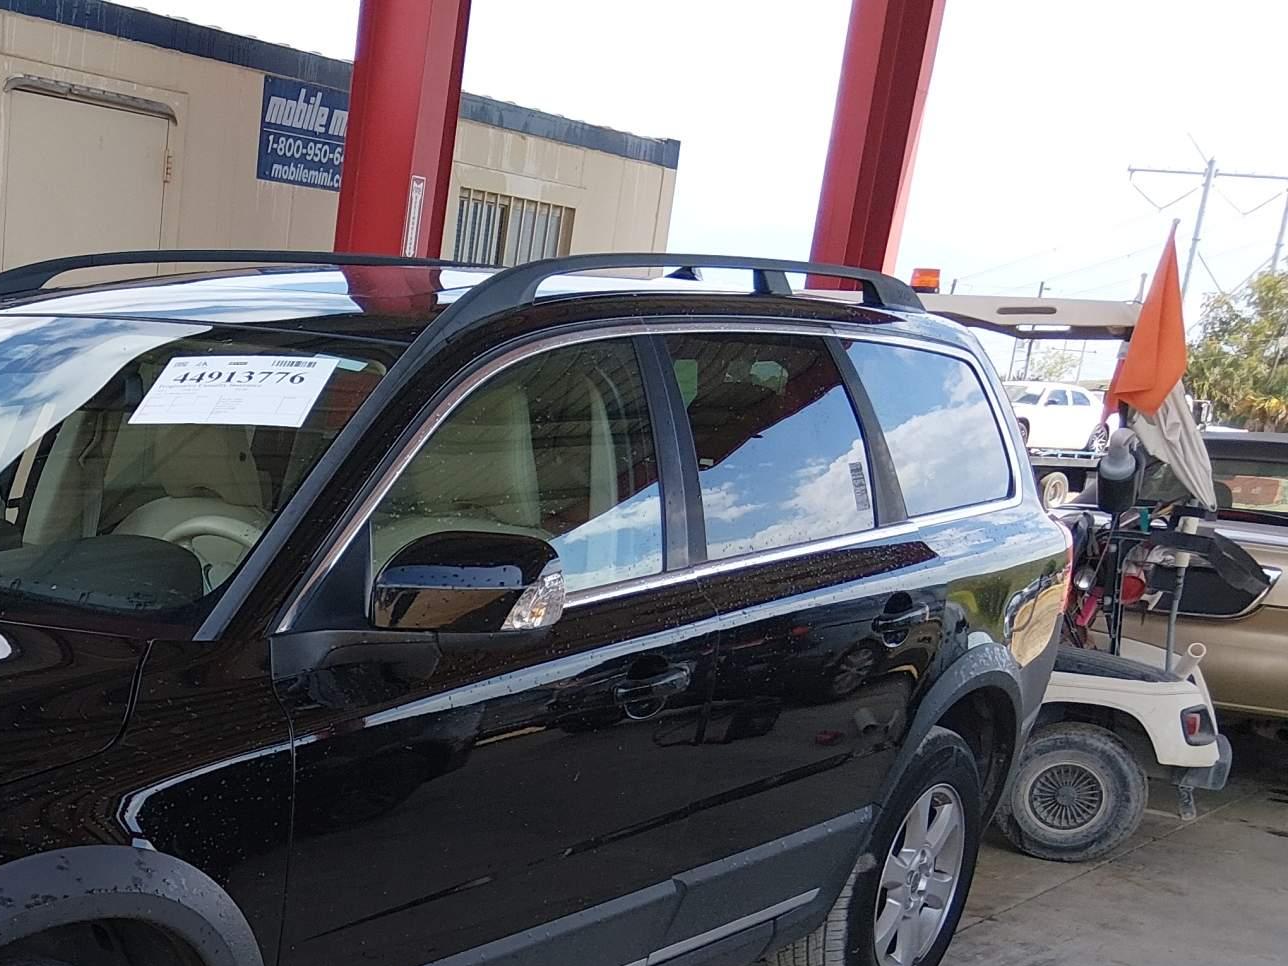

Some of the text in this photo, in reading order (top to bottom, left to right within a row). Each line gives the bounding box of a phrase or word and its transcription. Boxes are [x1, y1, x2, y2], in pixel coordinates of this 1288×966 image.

[265, 88, 329, 133] mobile
[267, 134, 344, 165] 1-800-950-6
[271, 162, 341, 188] mobilemini.c
[173, 370, 310, 385] 44913776
